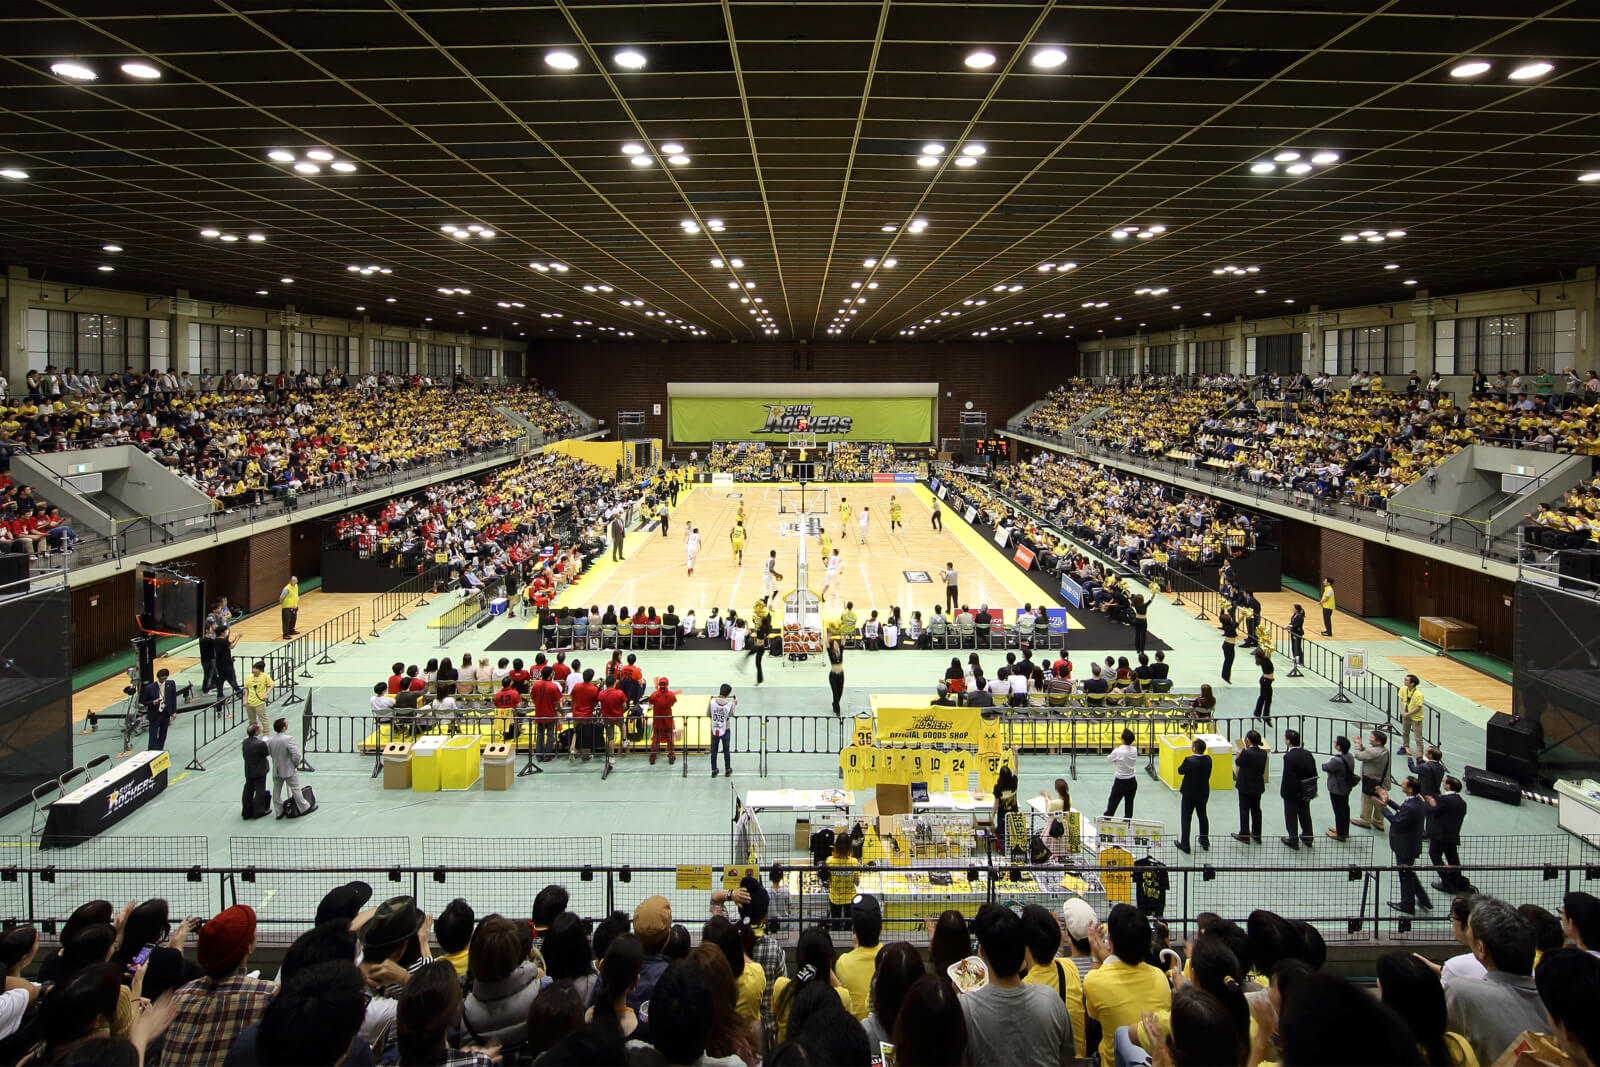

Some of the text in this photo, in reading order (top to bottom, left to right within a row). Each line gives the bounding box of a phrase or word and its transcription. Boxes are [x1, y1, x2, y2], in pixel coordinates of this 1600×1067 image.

[785, 405, 812, 416] SUN
[500, 694, 512, 705] 42
[889, 731, 969, 739] OFFICIAL GOODS SHOP
[850, 754, 857, 767] 0
[914, 756, 921, 769] 9
[931, 757, 941, 770] 10
[952, 759, 965, 772] 24
[103, 777, 156, 818] ROCKERS
